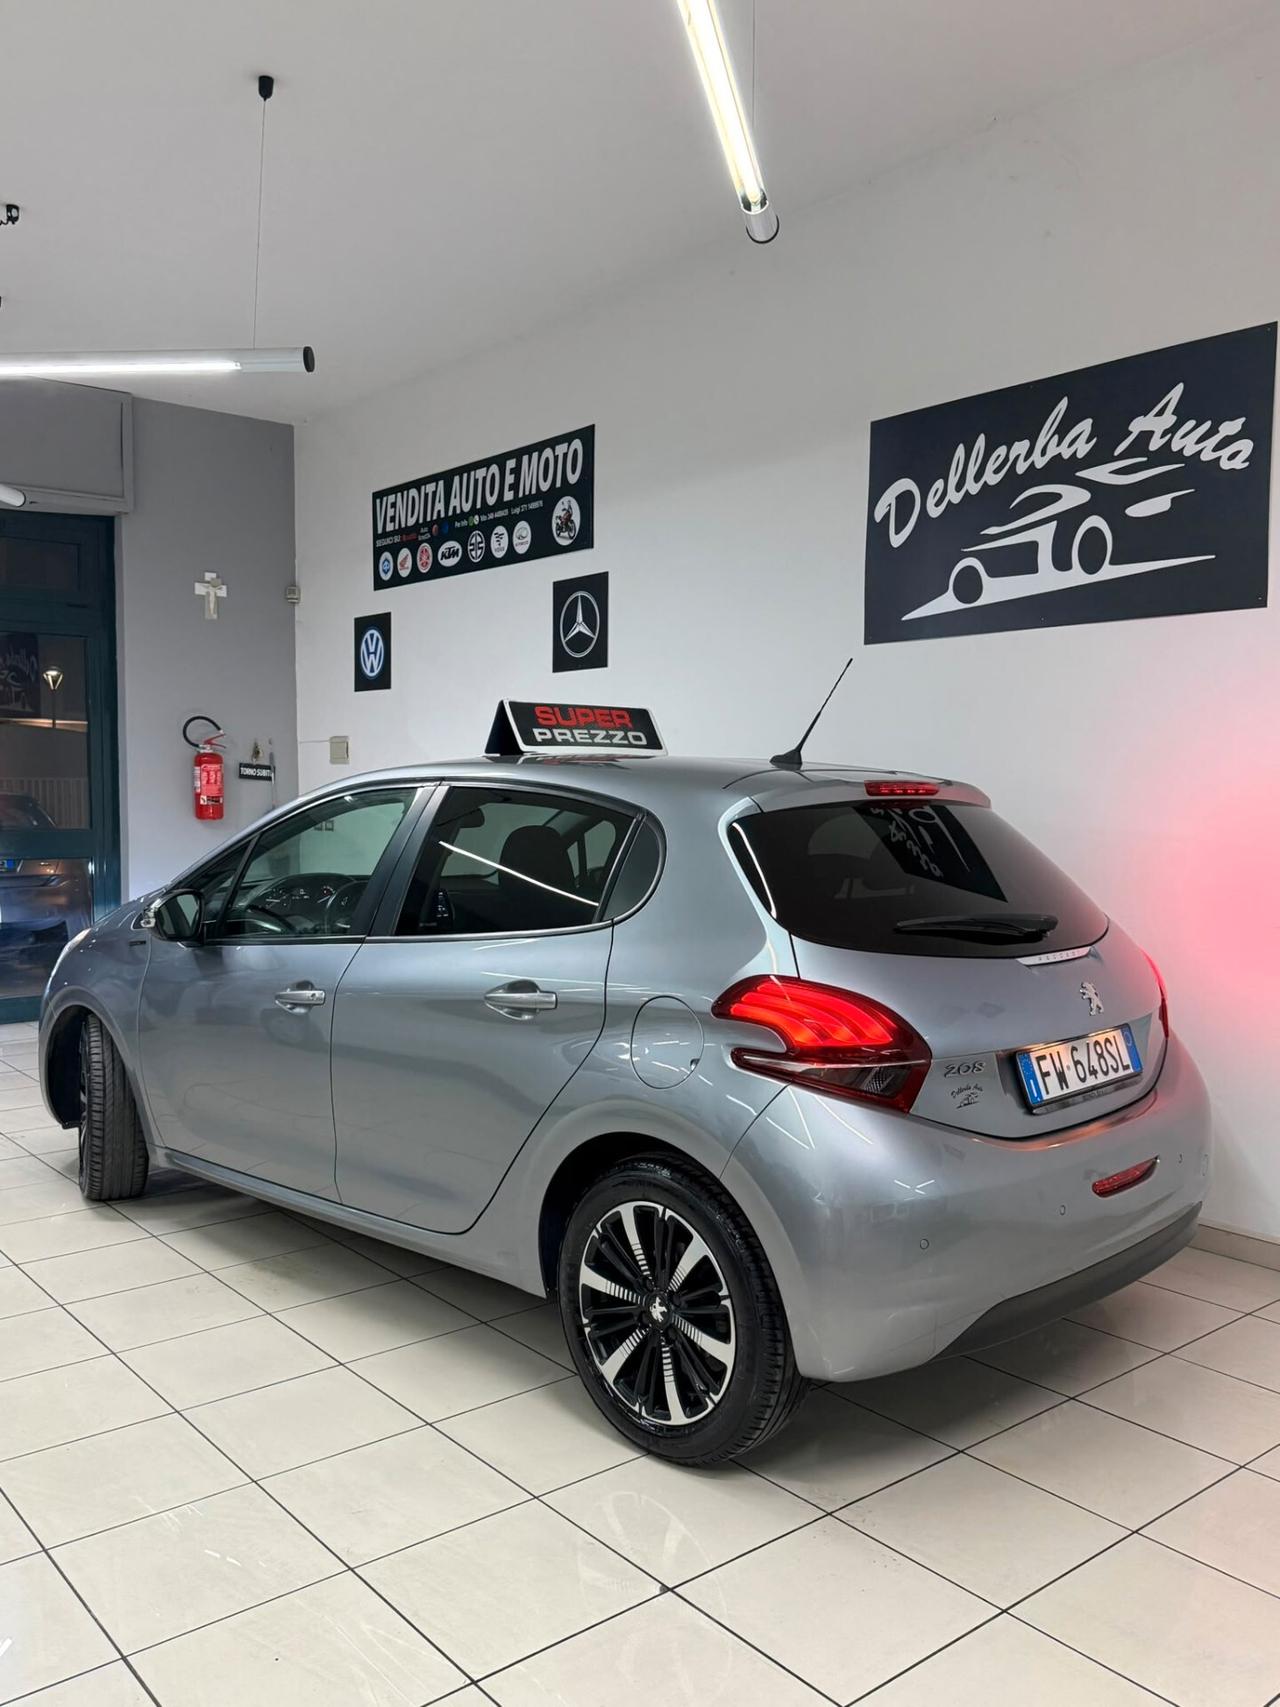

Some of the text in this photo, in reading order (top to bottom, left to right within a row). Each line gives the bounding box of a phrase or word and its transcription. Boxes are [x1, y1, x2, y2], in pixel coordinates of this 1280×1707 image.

[874, 382, 1254, 548] Dellerba Auto
[376, 439, 583, 534] VENDITA AUTO E MOTO
[440, 546, 460, 561] KTM
[534, 705, 633, 728] SUPER
[532, 728, 648, 745] PREZZO
[240, 767, 273, 777] TORNO SUBIT
[944, 1060, 985, 1078] 208
[1035, 1035, 1130, 1095] FW 648SL
